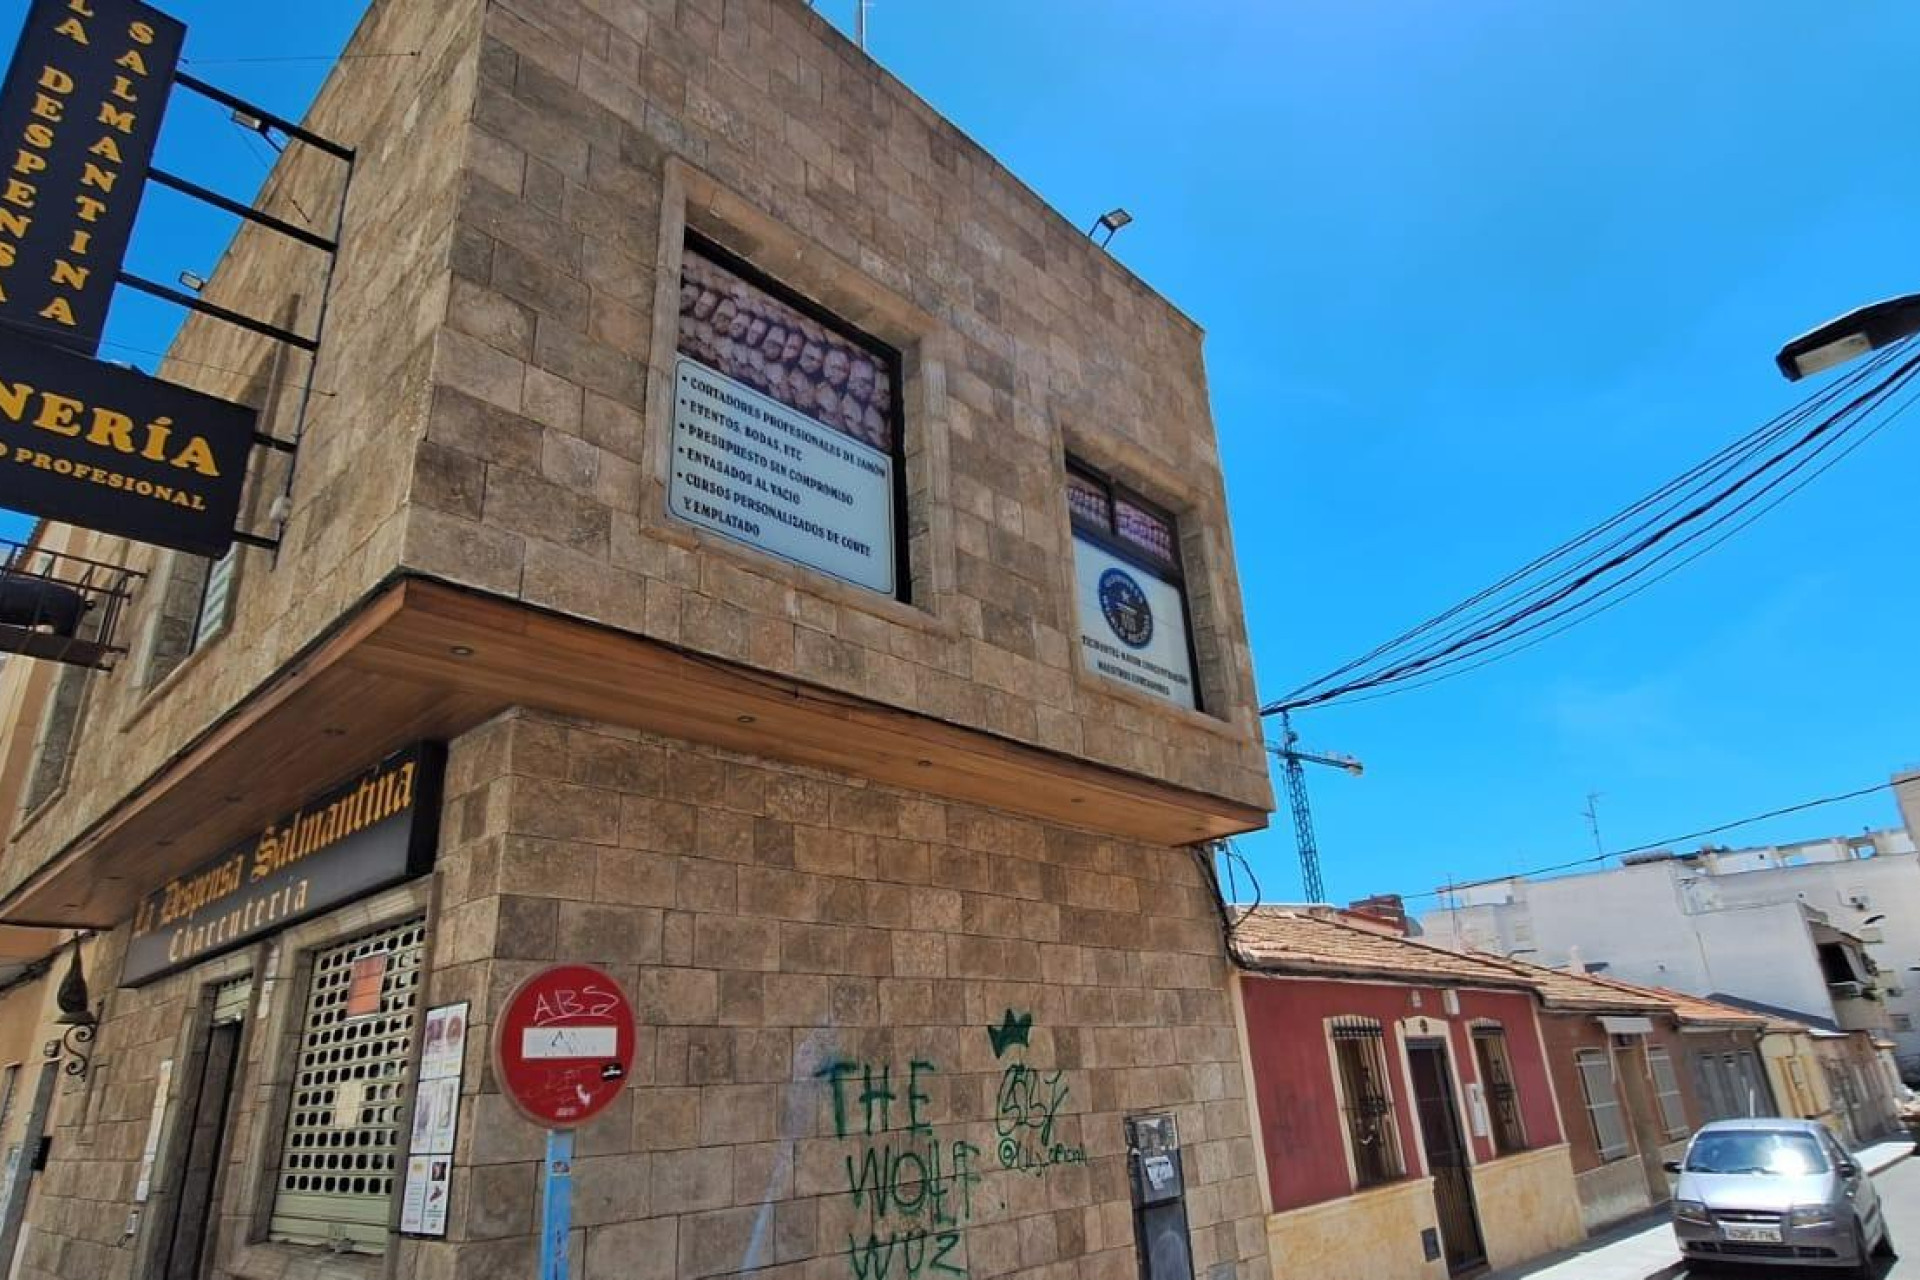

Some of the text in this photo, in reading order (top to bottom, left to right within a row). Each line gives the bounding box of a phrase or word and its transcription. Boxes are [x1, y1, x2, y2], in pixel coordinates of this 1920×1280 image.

[54, 0, 94, 45] LA
[39, 20, 155, 326] SALMANTINA
[690, 377, 761, 420] CORTADORES
[763, 411, 842, 458] PROFESIONALES
[843, 449, 855, 465] DE
[14, 447, 206, 511] PROFESIONAL
[686, 447, 752, 485] ENVASADOS
[755, 476, 769, 493] AL
[688, 423, 768, 468] PRESUPUESTO
[789, 468, 853, 506] COMPROMISO
[685, 472, 871, 557] CURSOS PERSONALIZADOS DE CORTE
[693, 500, 760, 536] EMPLATADO
[250, 762, 416, 883] Salmantina
[813, 1060, 935, 1141] THE
[846, 1138, 982, 1227] WOLF
